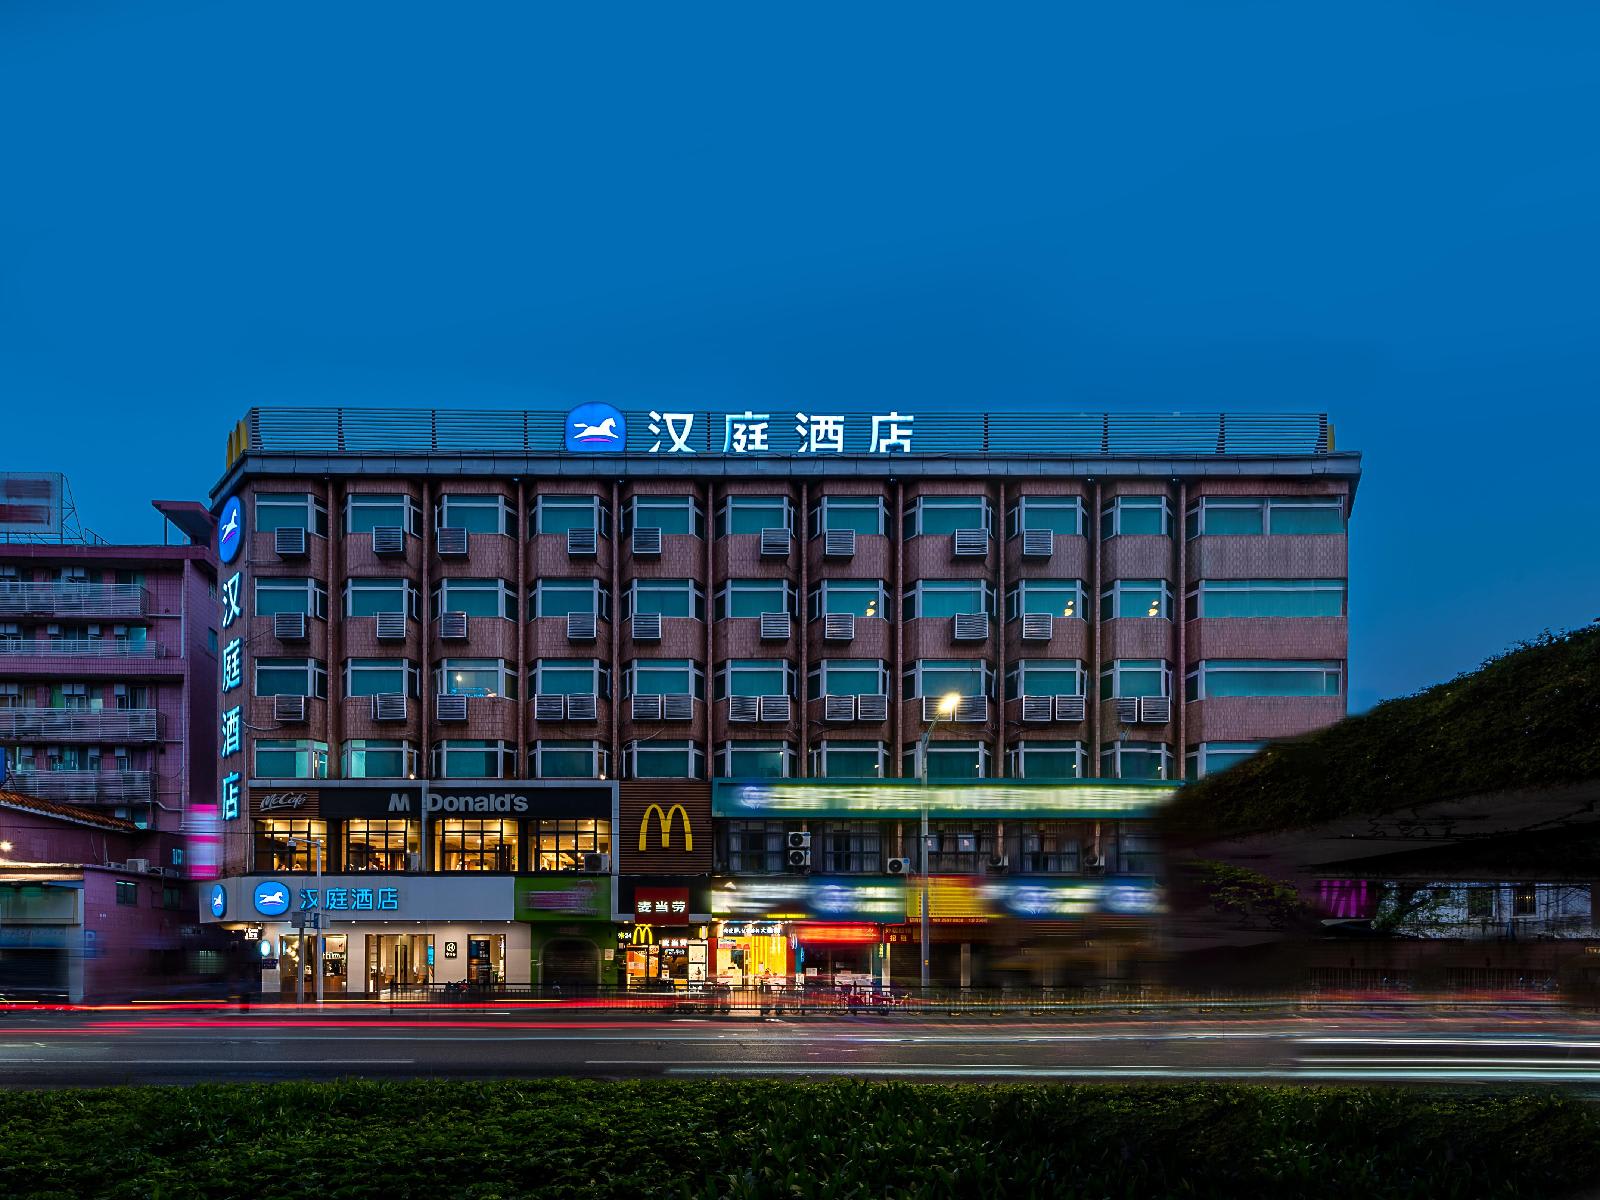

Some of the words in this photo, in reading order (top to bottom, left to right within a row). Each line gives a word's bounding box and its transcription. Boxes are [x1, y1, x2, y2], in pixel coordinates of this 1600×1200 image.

[648, 410, 914, 453] 汉庭酒店
[222, 572, 241, 821] 汉庭酒店
[300, 888, 398, 910] 汉庭酒店
[637, 901, 686, 913] 麦当劳
